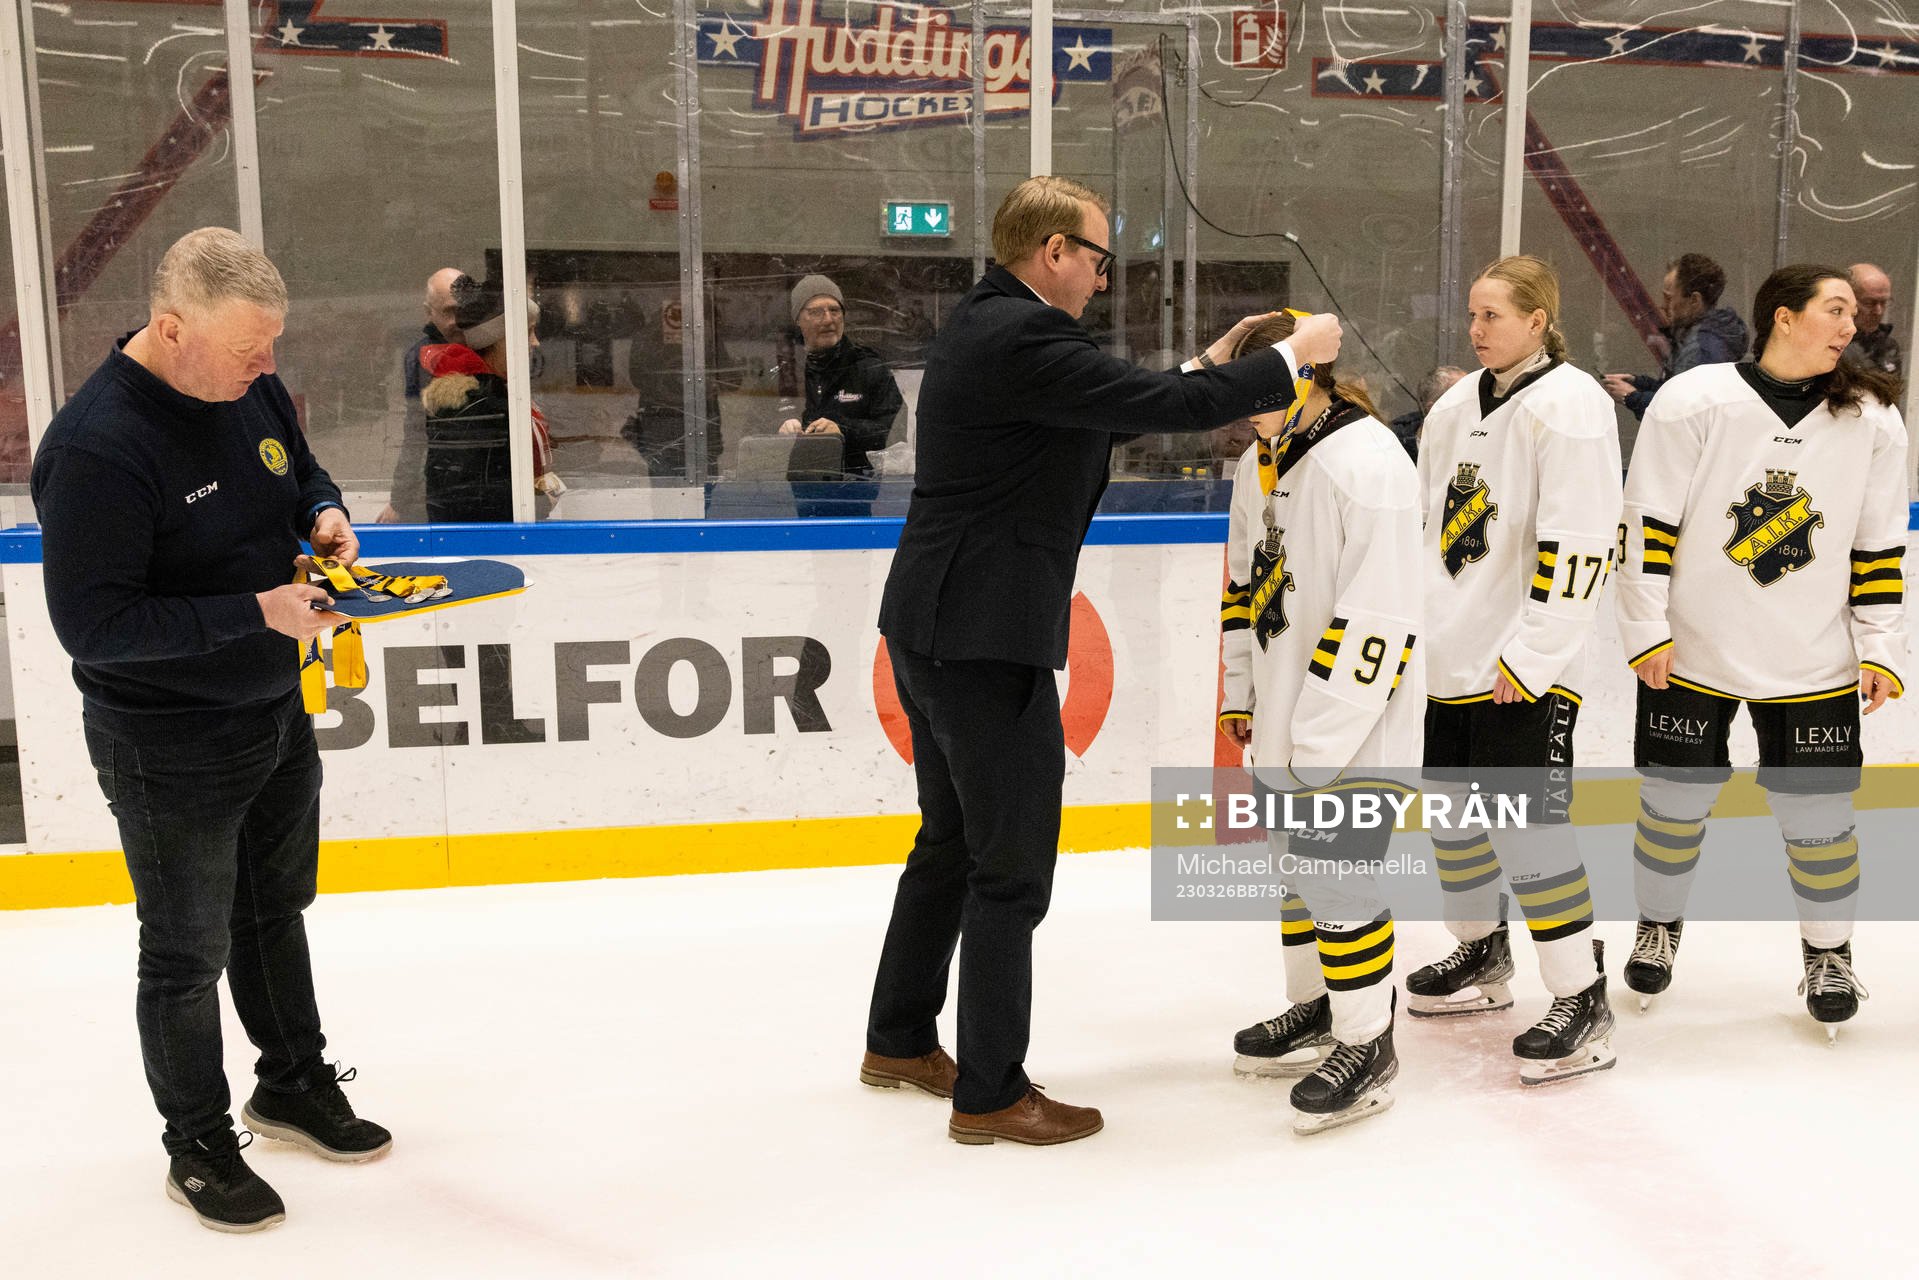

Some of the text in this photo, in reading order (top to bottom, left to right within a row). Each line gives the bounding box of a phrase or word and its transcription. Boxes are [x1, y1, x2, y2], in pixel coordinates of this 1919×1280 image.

[1306, 407, 1332, 440] CCM
[1773, 436, 1803, 445] CCM
[184, 480, 219, 504] CCM
[1270, 489, 1290, 498] CM
[1560, 554, 1603, 600] 17
[1353, 635, 1387, 686] 9
[310, 636, 832, 751] BELFOR
[1649, 712, 1709, 737] LEXLY
[1664, 733, 1683, 743] MADE
[1684, 736, 1704, 745] EASY
[1795, 726, 1852, 744] LEXLY
[1801, 837, 1834, 846] CCM
[1512, 872, 1541, 881] CCM
[1316, 921, 1344, 930] CCM
